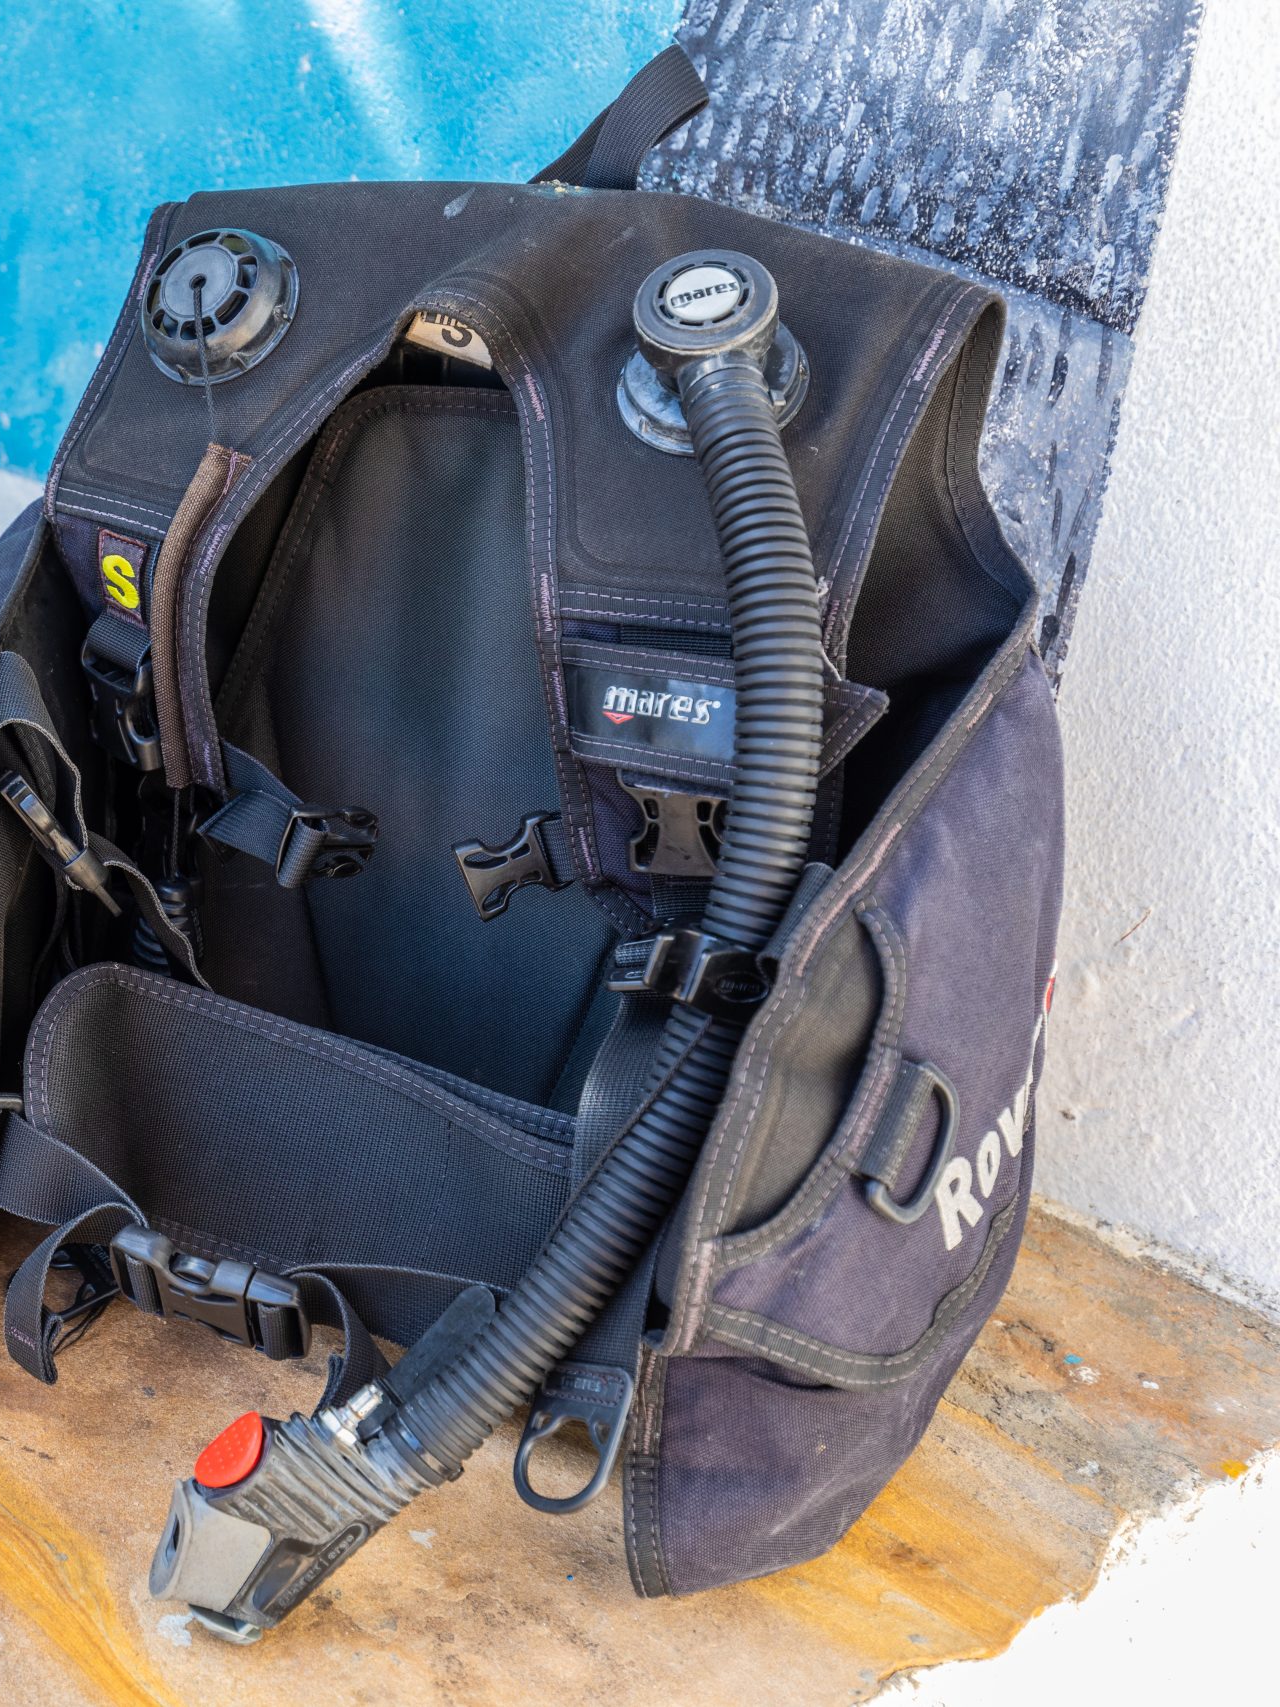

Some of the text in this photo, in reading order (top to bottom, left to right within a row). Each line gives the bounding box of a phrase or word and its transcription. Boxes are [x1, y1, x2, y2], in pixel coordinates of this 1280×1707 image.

[670, 281, 739, 307] mares
[102, 554, 140, 609] S
[602, 685, 714, 725] mares
